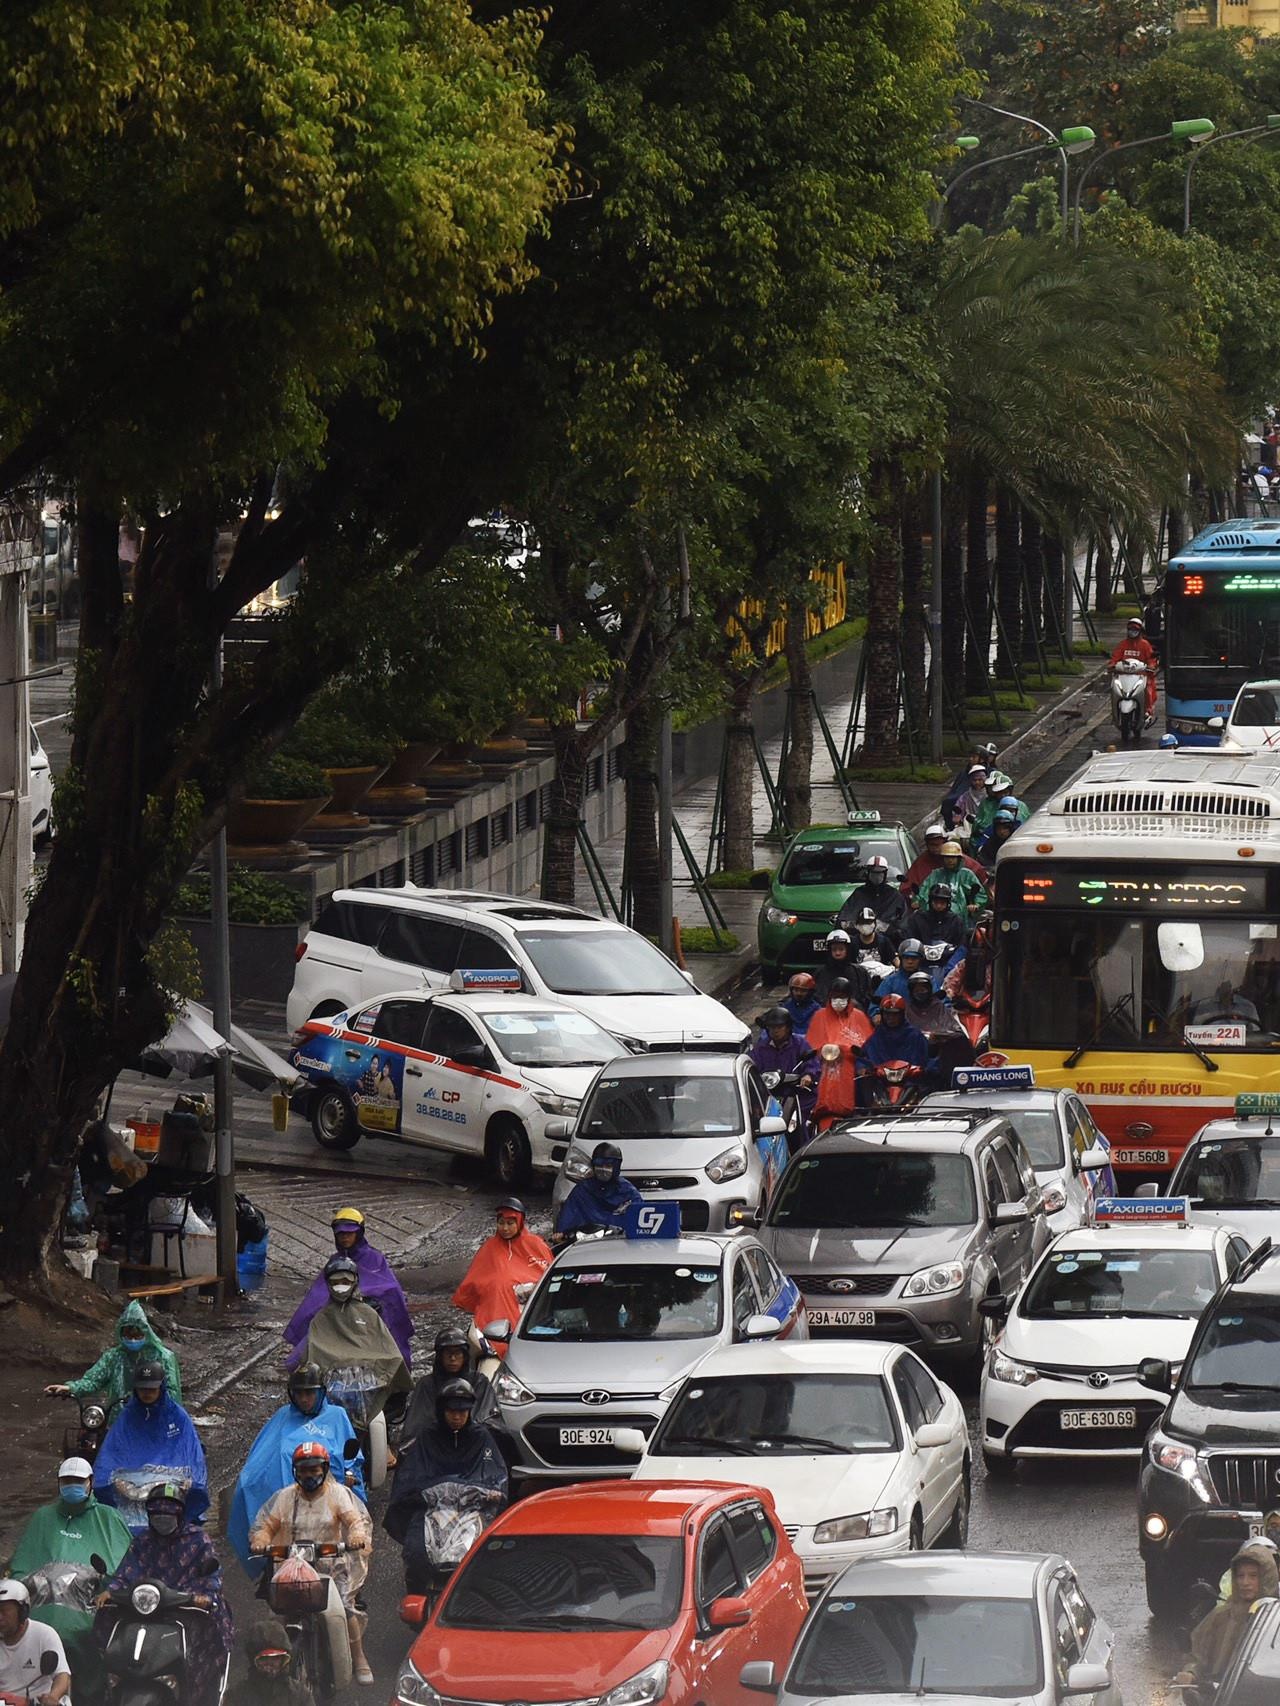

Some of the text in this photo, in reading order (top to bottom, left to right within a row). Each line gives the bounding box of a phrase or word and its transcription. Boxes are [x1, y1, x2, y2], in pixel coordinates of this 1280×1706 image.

[850, 811, 877, 819] TAXI
[469, 975, 519, 984] TAXIGROUP
[1217, 1028, 1241, 1039] 22A
[1004, 1071, 1028, 1081] LONG
[1076, 1083, 1095, 1095] XN
[1101, 1083, 1125, 1095] BUS
[442, 1090, 460, 1103] CP
[416, 1103, 467, 1125] 38.26.26.26
[1106, 1205, 1184, 1214] TAXIGROUP
[638, 1206, 665, 1235] G7
[808, 1310, 874, 1326] 29A-407.98
[1063, 1411, 1133, 1427] 30E-630.69
